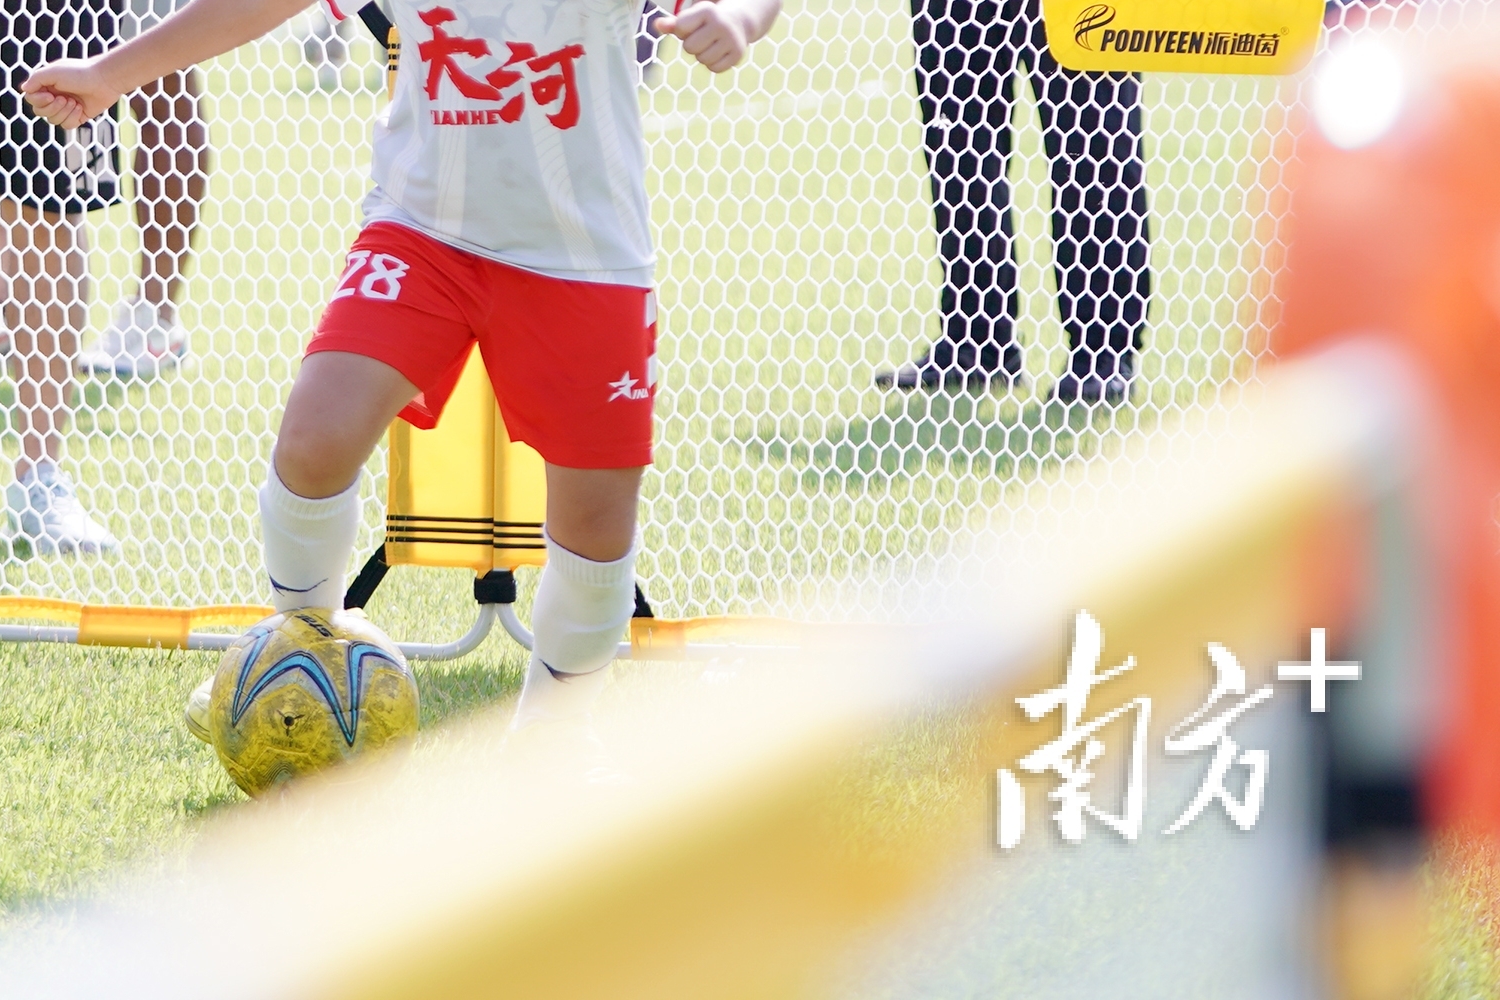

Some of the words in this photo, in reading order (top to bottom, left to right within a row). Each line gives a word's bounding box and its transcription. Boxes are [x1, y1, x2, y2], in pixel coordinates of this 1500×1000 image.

[417, 5, 587, 130] 天河
[1100, 28, 1207, 54] PODIYEEN
[1203, 30, 1281, 57] 派迪茵
[330, 249, 411, 303] 28
